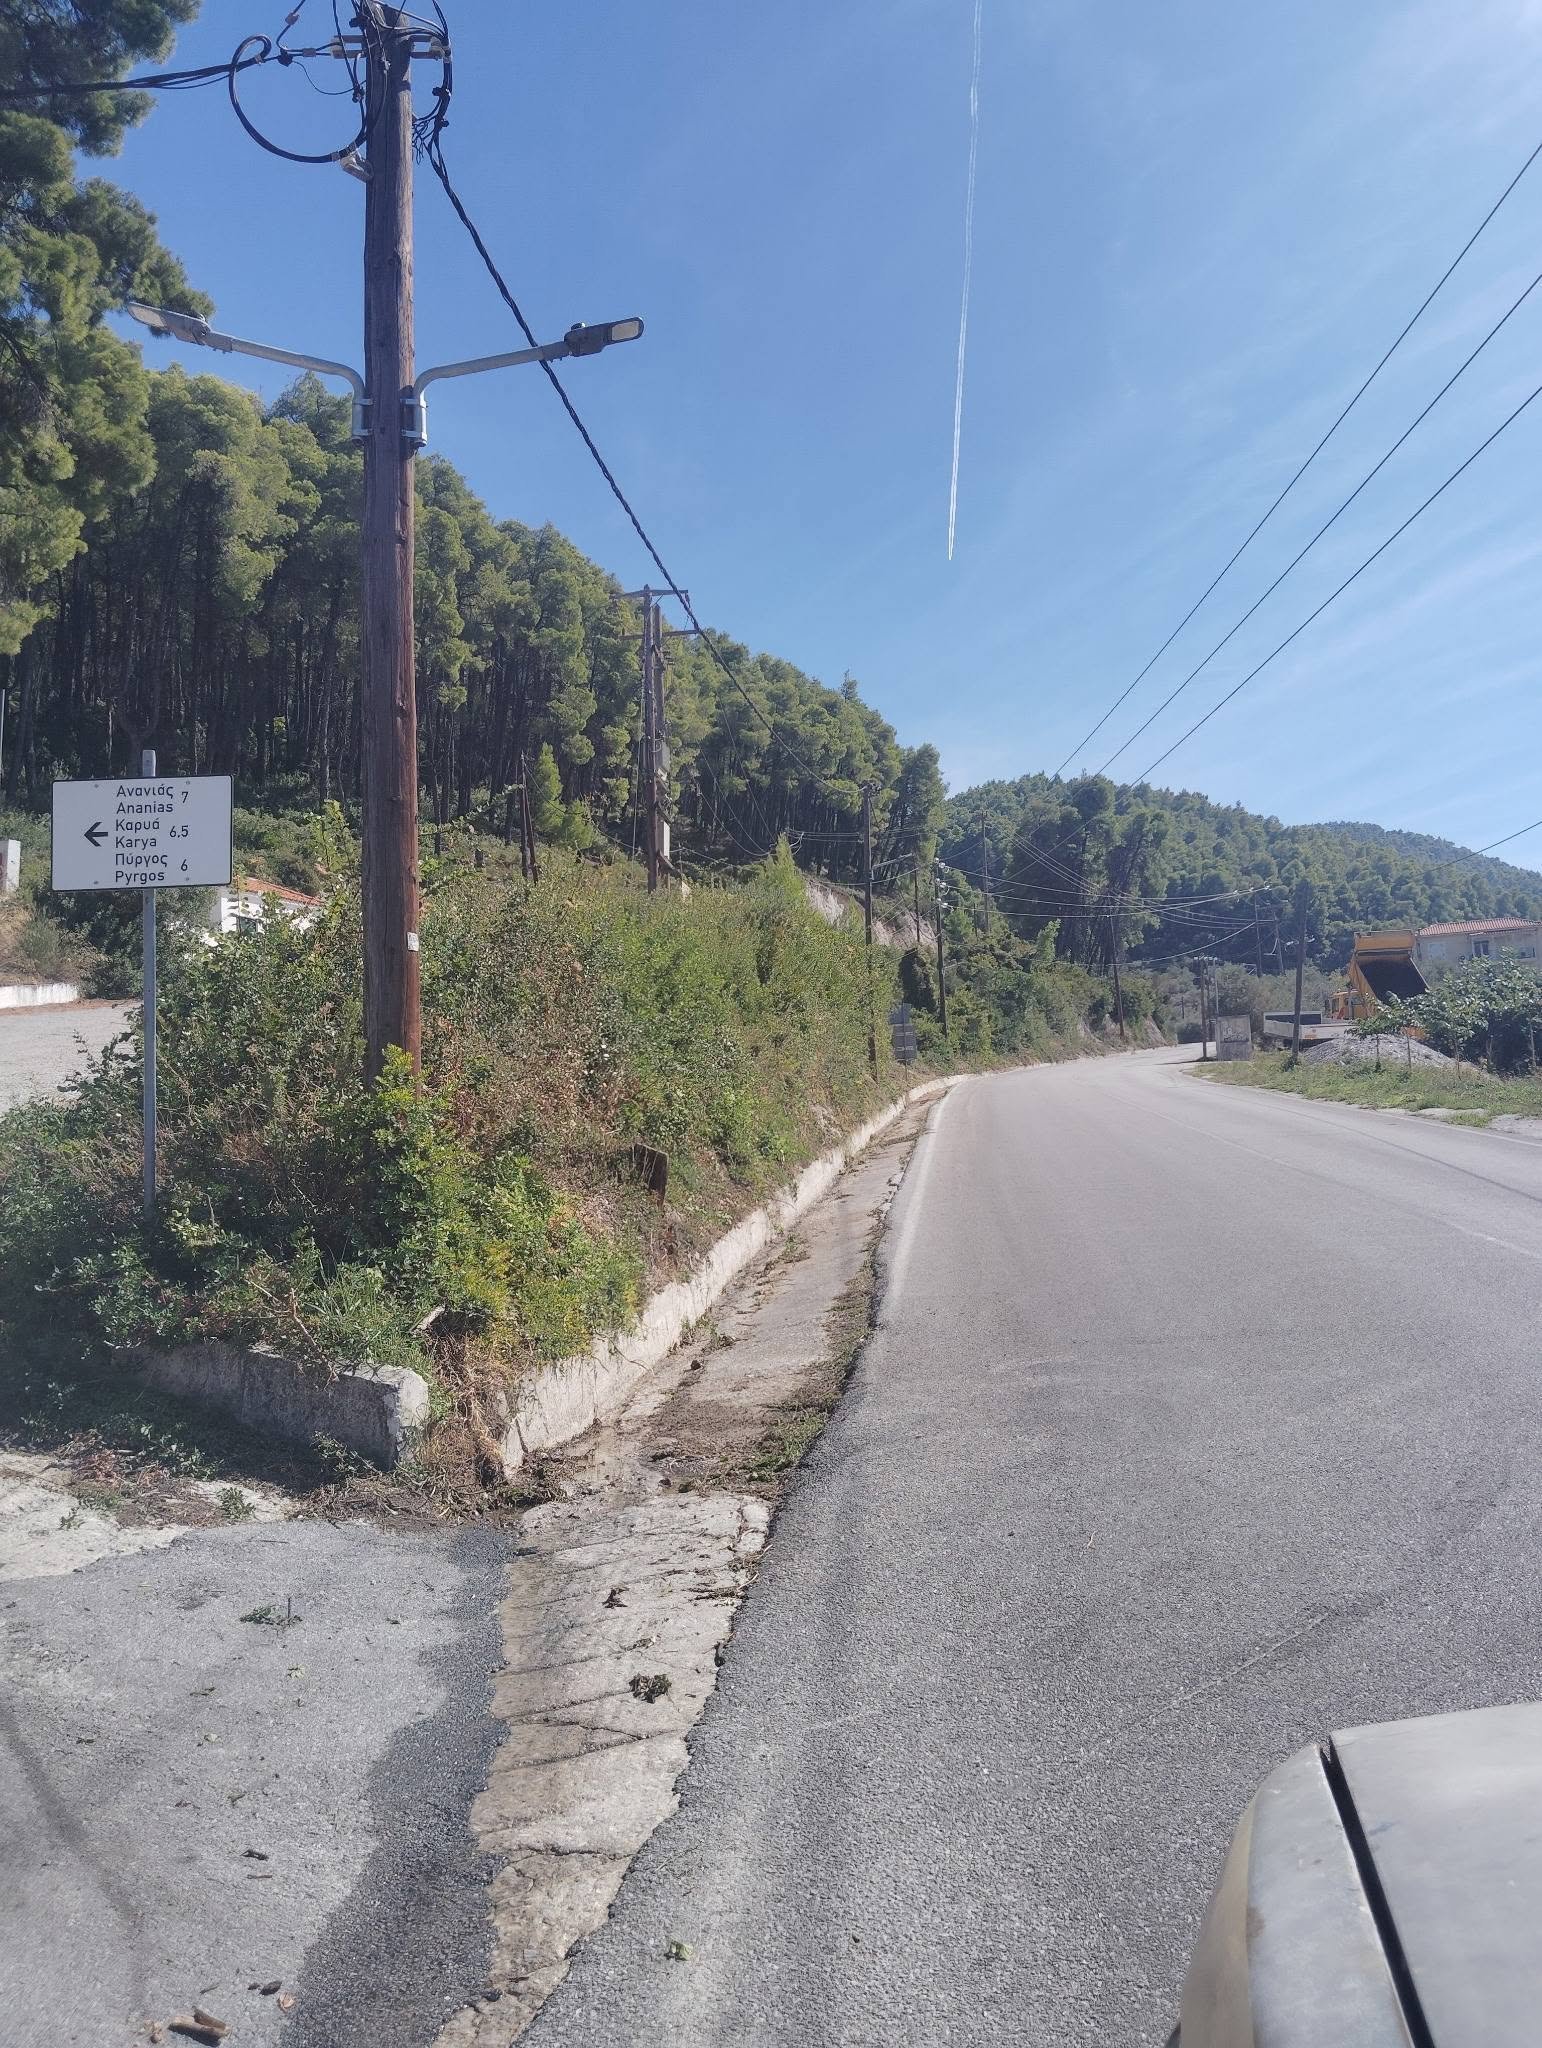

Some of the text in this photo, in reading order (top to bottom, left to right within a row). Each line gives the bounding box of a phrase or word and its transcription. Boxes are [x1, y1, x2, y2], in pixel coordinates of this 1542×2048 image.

[117, 784, 174, 799] Ανανιάς
[181, 792, 189, 803] 7
[116, 802, 173, 814] Ananias
[116, 818, 159, 832] Καρυά
[116, 836, 157, 850] Karya
[116, 854, 167, 867] Πύργος
[181, 859, 188, 871] 6
[115, 871, 164, 885] Pyrgos
